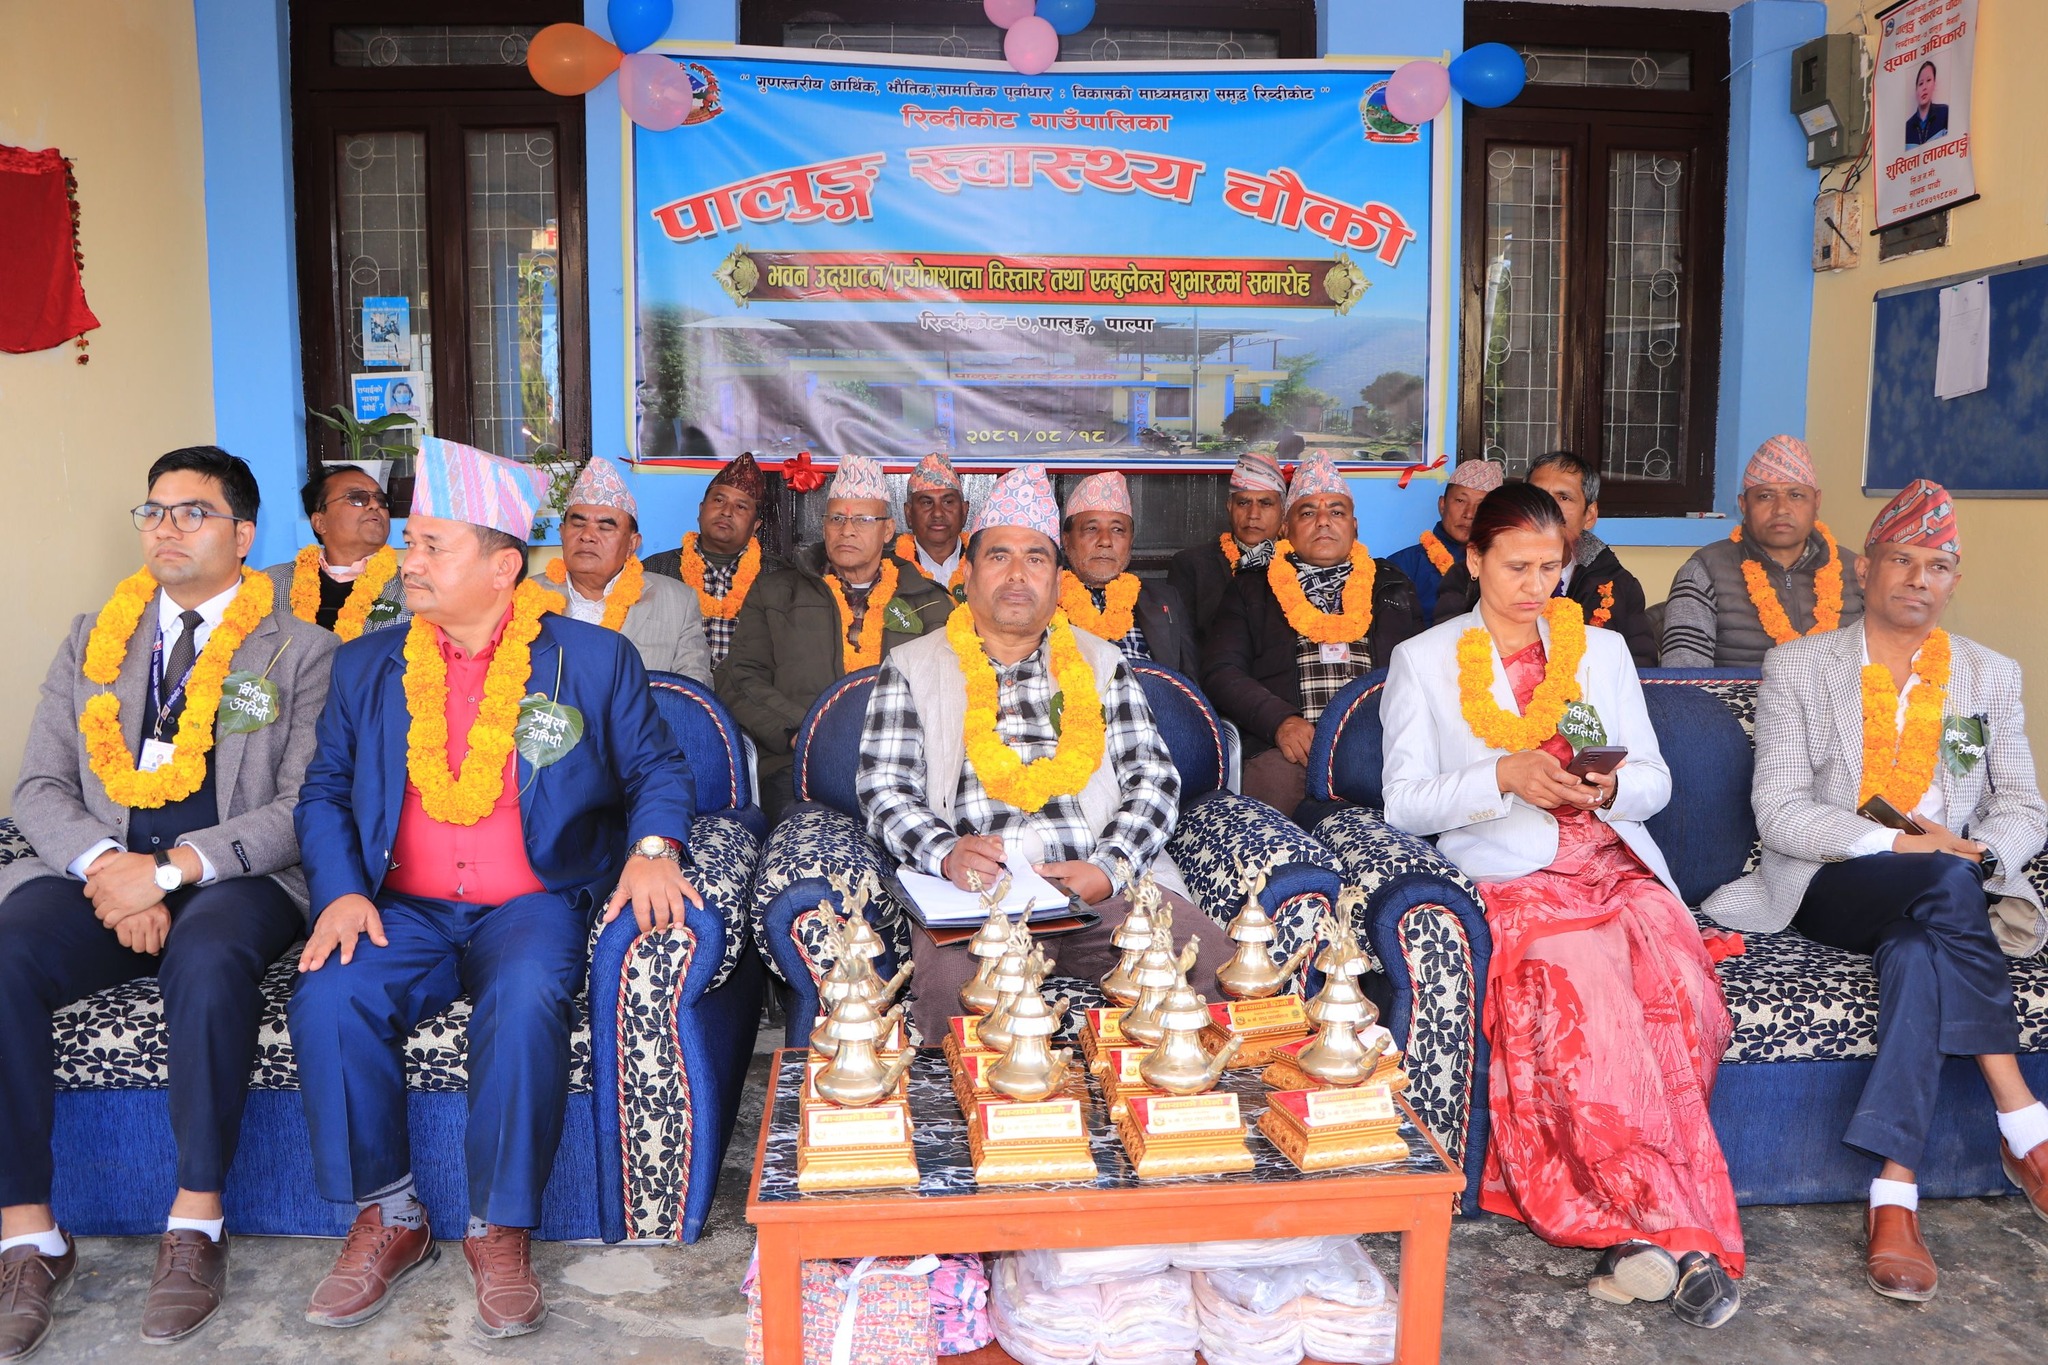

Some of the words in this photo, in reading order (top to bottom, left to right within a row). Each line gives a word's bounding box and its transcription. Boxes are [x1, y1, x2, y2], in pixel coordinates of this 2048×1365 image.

[1883, 49, 1918, 73] सूचना
[1920, 21, 1967, 56] अधिकारी
[756, 76, 823, 93] गुणस्तरीय
[1003, 82, 1053, 102] पूर्वाधार
[1072, 83, 1133, 102] विकासको
[1138, 86, 1210, 103] माध्यमद्वारा
[1029, 107, 1173, 133] गाउँपालिका
[907, 143, 1206, 207] स्वास्थ्य
[1224, 166, 1417, 268] चौकी
[767, 264, 809, 289] भवन
[987, 260, 1046, 293] विस्तार
[1049, 266, 1084, 293] तथा
[1089, 262, 1165, 298] एम्बुलेन्स
[1169, 268, 1242, 299] शुभारम्भ
[1246, 265, 1311, 298] समारोह
[1103, 316, 1155, 333] पाल्पा
